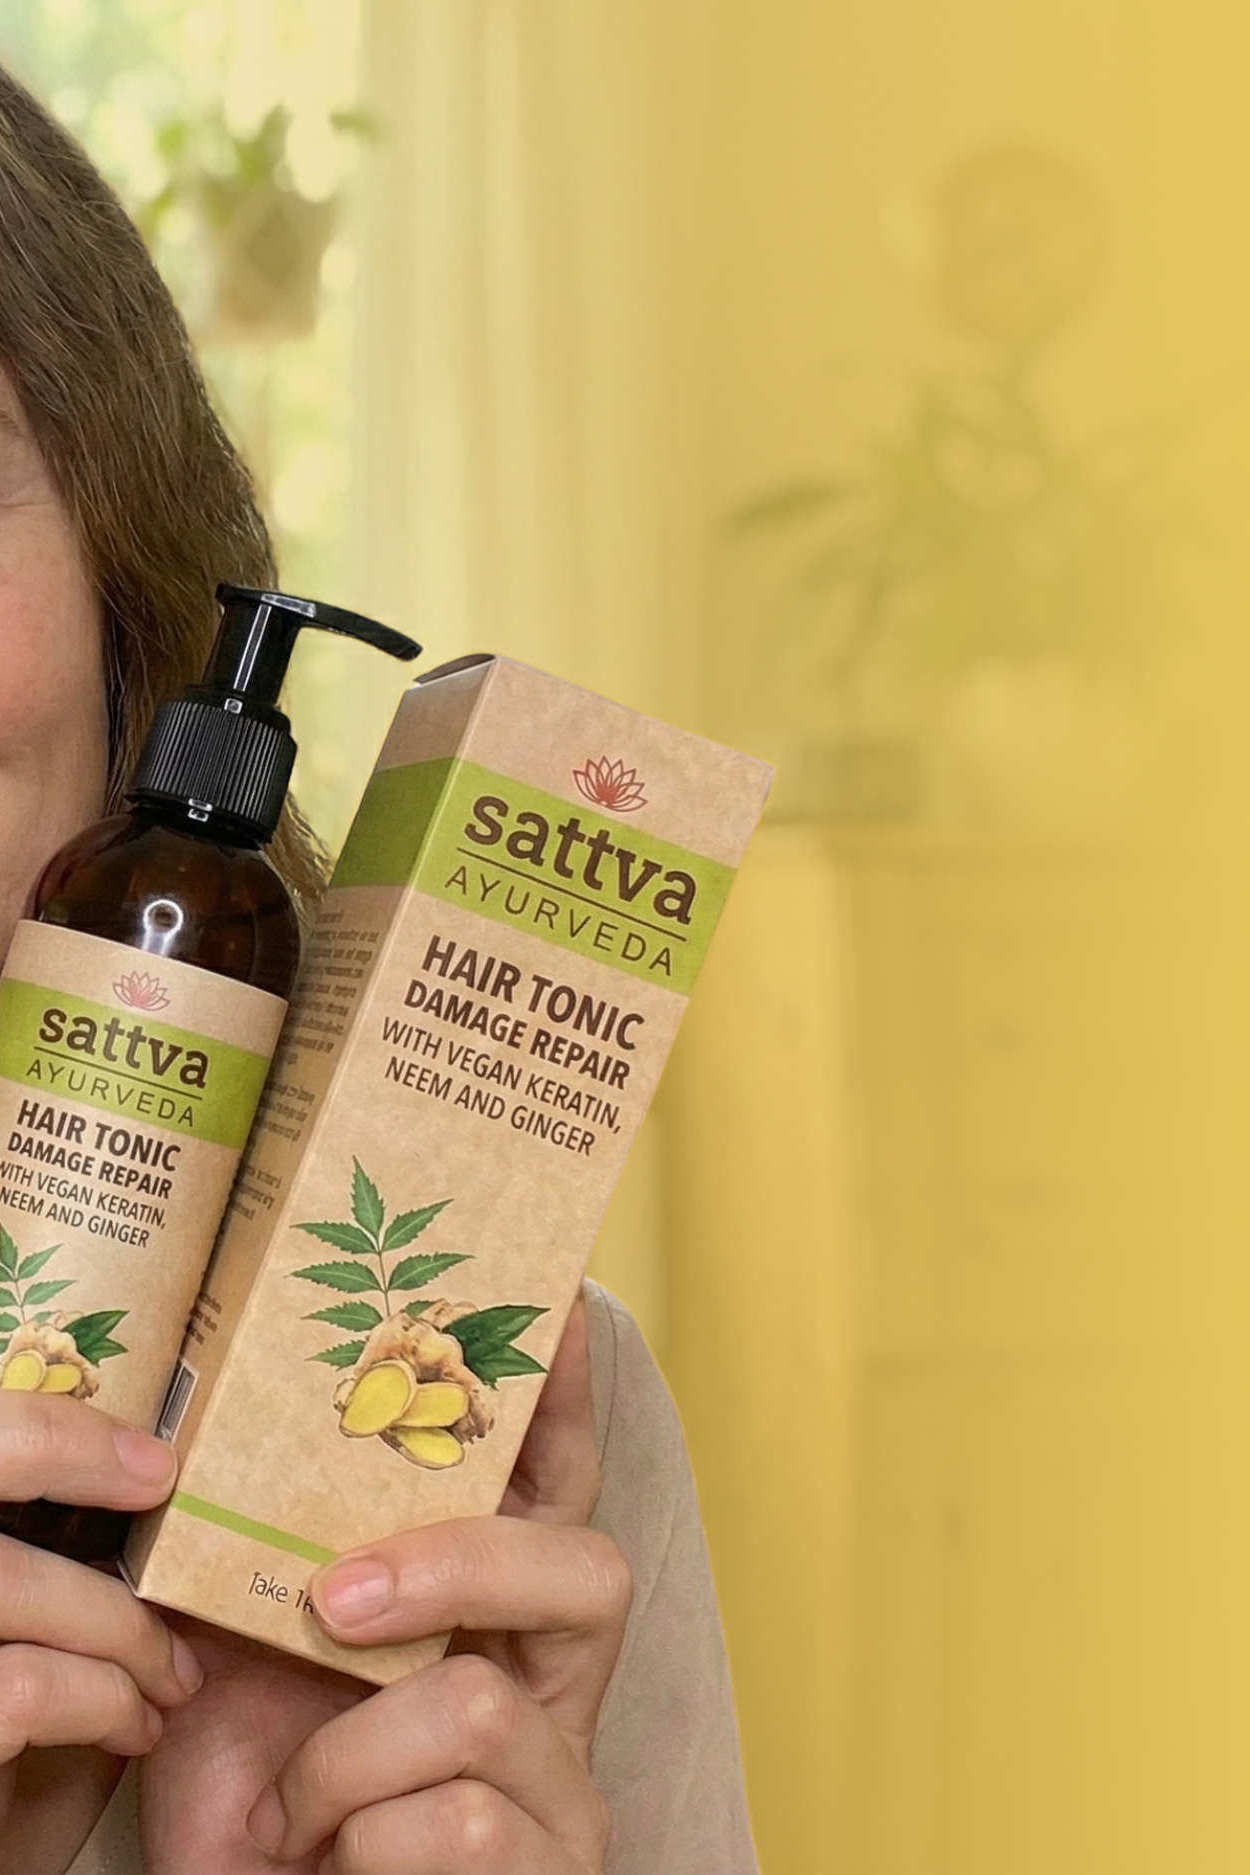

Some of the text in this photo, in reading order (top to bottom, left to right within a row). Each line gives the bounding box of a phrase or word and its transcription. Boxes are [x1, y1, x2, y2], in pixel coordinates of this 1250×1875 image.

[464, 796, 697, 925] sattva
[445, 866, 672, 976] AYURVEDA
[421, 934, 645, 1051] HAIR TONIC
[39, 1008, 210, 1089] sattva
[403, 979, 631, 1090] DAMAGE REPAIR
[25, 1058, 195, 1127] AYURVEDA
[382, 1016, 443, 1060] WITH
[447, 1041, 523, 1090] VEGAN
[525, 1073, 621, 1135] KERATIN,
[385, 1056, 595, 1156] NEEM AND GINGER
[7, 1131, 173, 1199] DAMAGE REPAIR
[16, 1099, 181, 1172] HAIR TONIC
[37, 1171, 94, 1205] VEGAN
[97, 1193, 166, 1230] KERATIN,
[46, 1202, 84, 1229] AND
[88, 1215, 150, 1248] GINGER
[248, 1571, 289, 1603] Take
